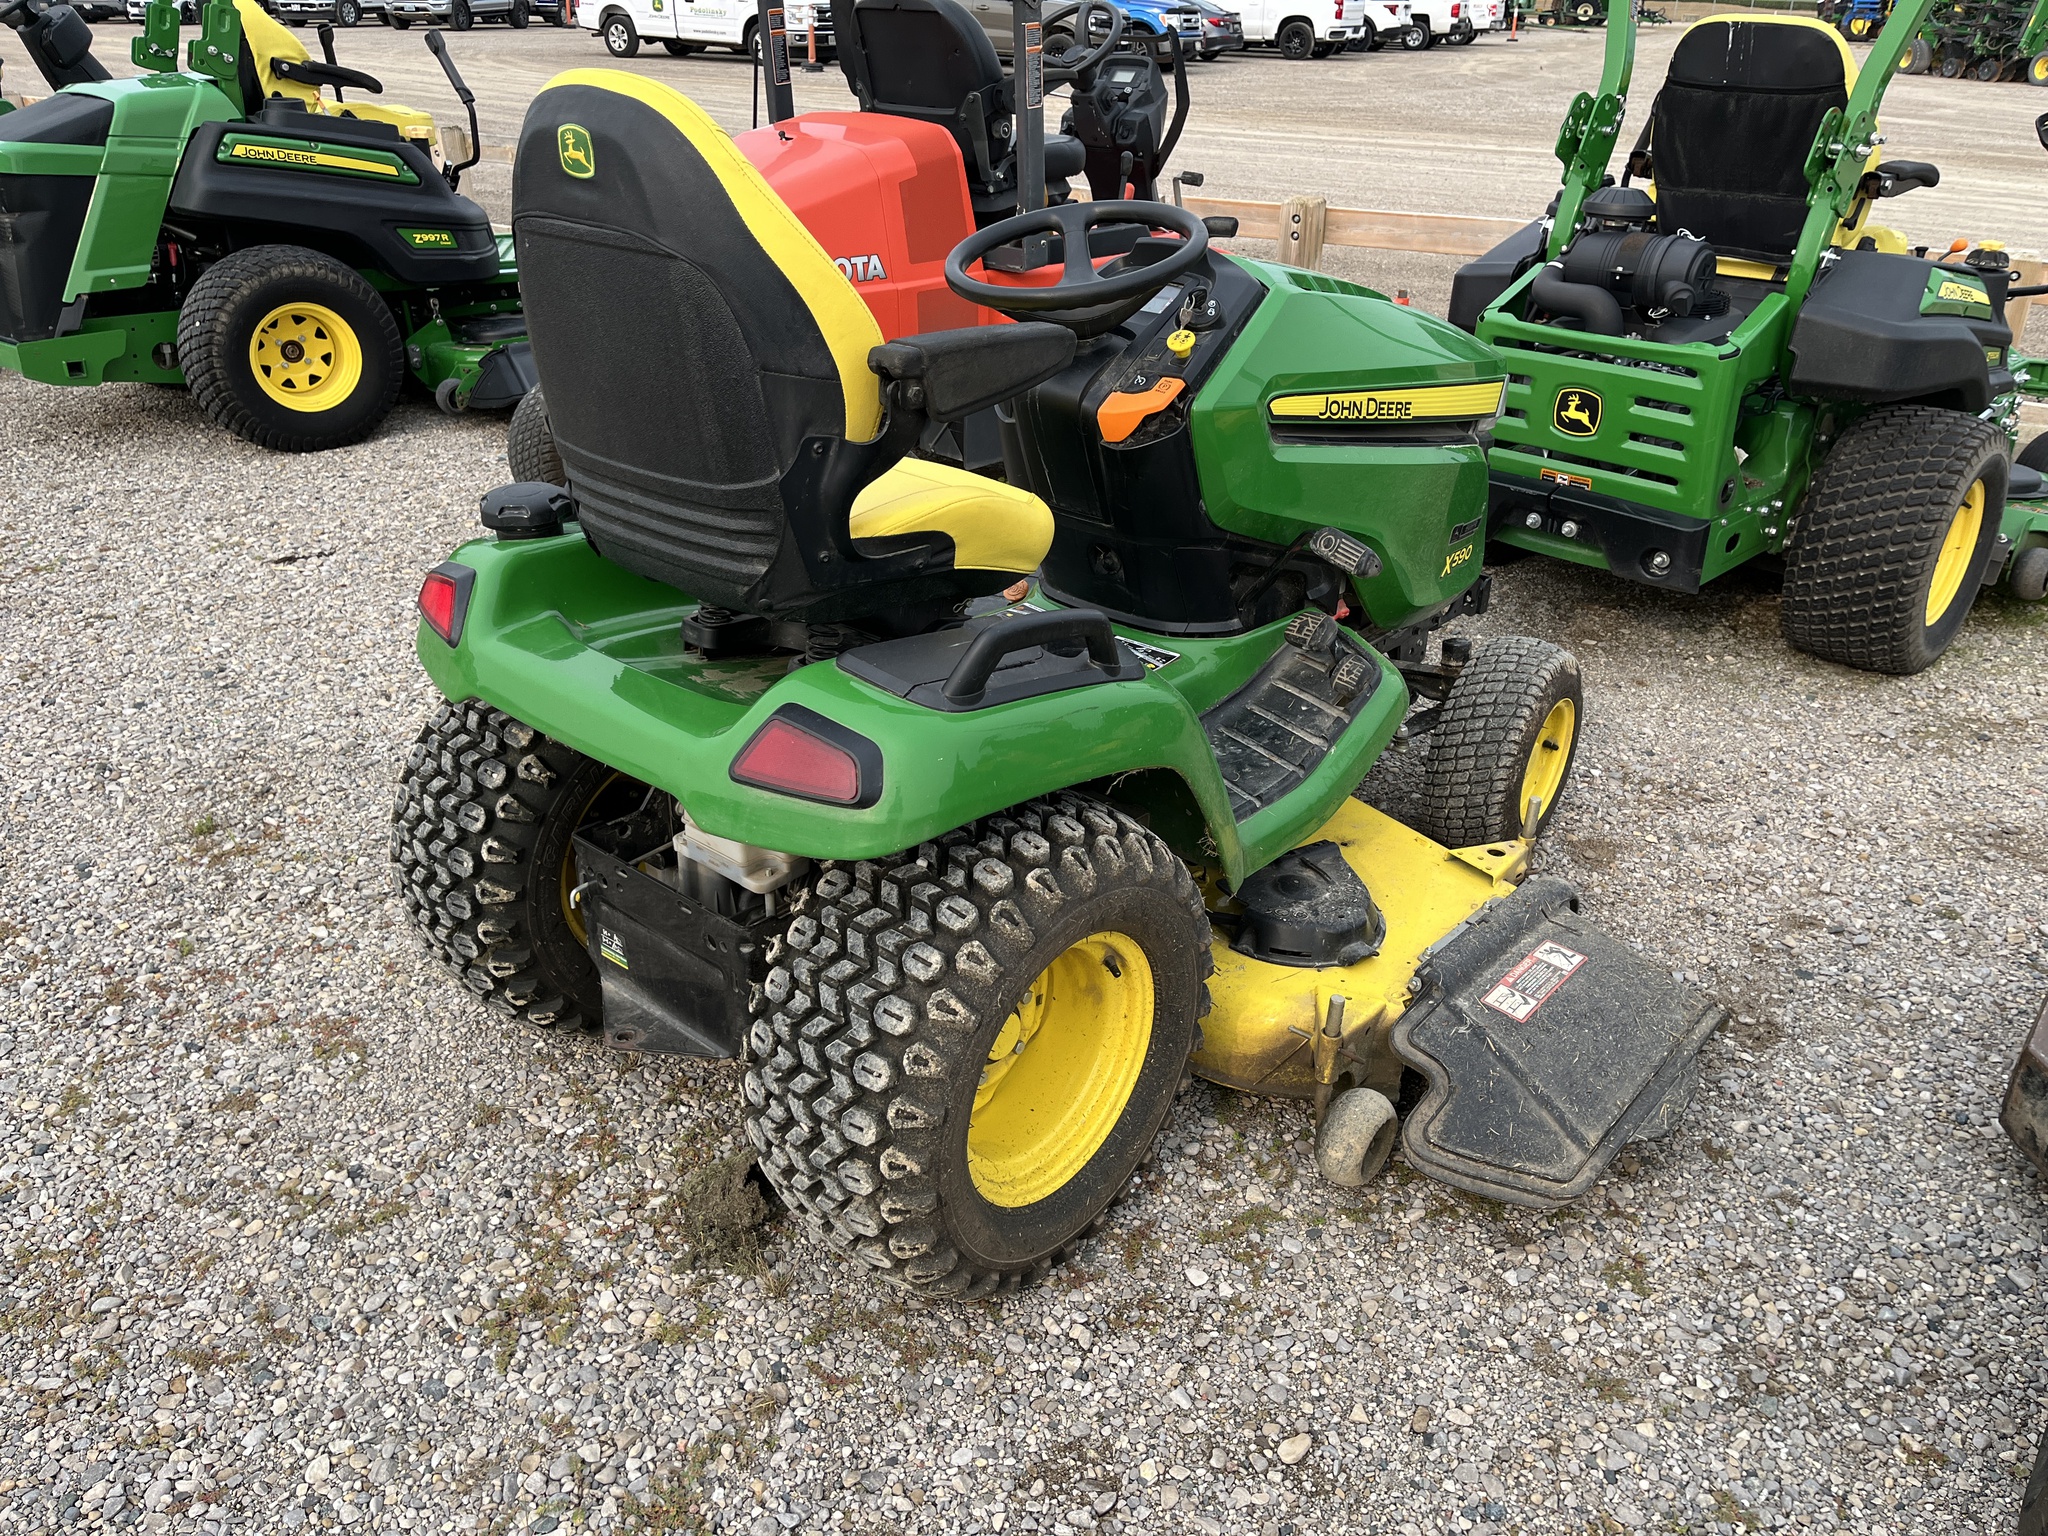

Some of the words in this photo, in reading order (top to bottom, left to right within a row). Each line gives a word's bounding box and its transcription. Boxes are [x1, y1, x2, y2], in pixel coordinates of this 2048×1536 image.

[690, 6, 727, 17] Podolinsky
[241, 147, 275, 160] JOHN
[276, 150, 317, 164] DEERE
[1318, 396, 1364, 419] JOHN
[1365, 396, 1413, 419] DEERE
[1440, 544, 1473, 578] X590
[1509, 958, 1535, 980] DANGER
